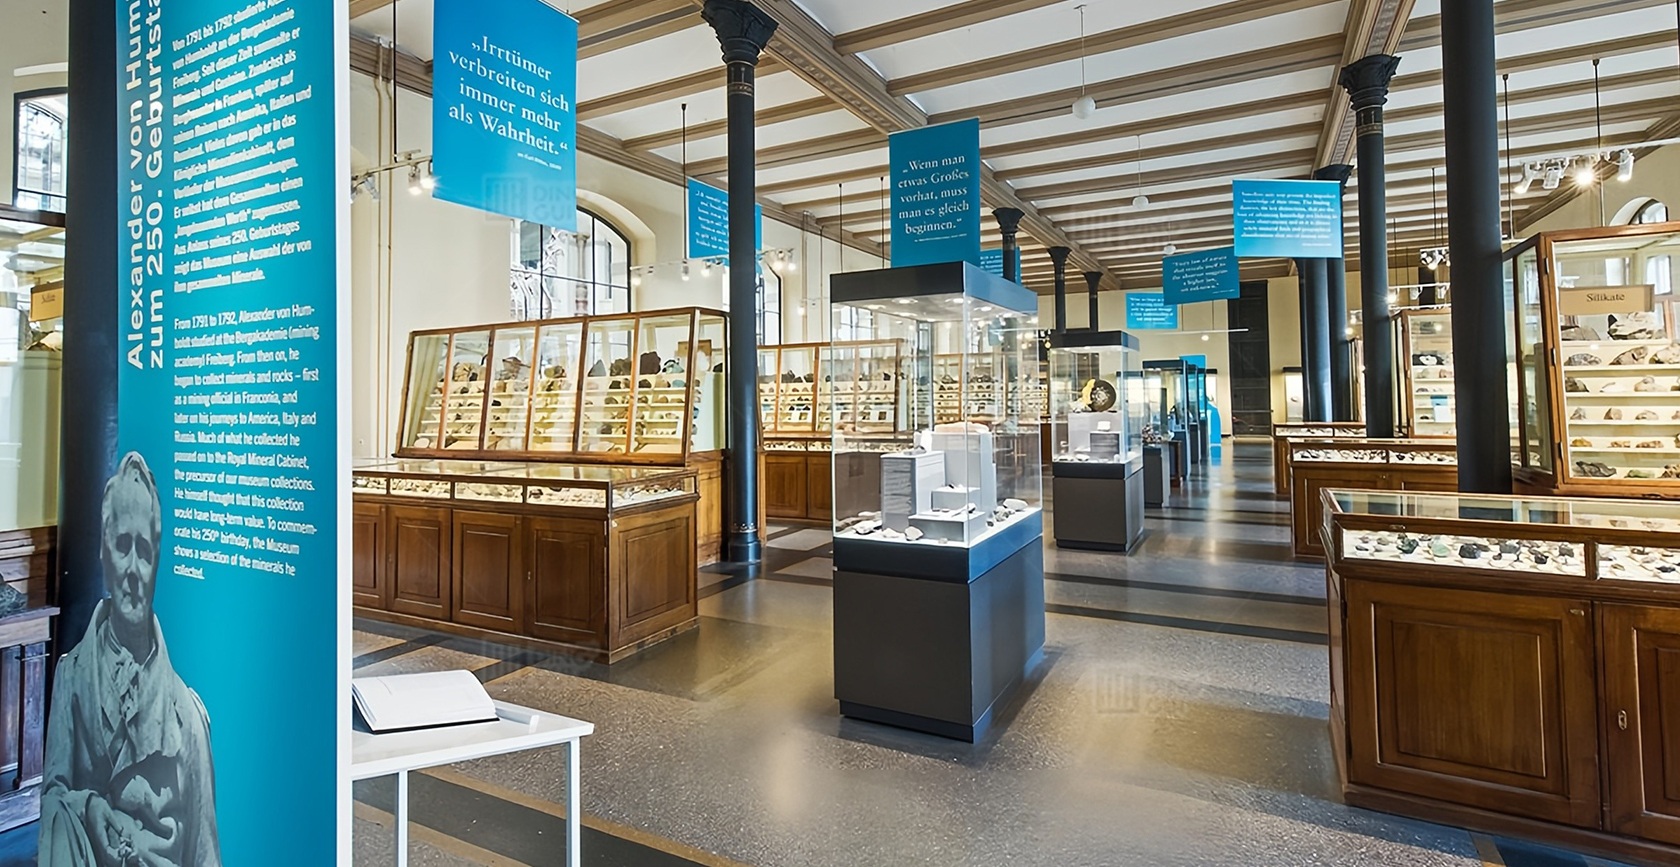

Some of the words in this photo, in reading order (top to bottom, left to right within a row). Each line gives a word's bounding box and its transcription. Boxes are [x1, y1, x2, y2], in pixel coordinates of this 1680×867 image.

[126, 0, 143, 90] Hum
[472, 35, 552, 81] „Irrtümer
[448, 51, 536, 98] verbreiten
[540, 90, 570, 113] sich
[459, 77, 516, 115] immer
[521, 106, 561, 132] mehr
[130, 100, 143, 169] von
[449, 103, 473, 125] als
[898, 177, 928, 188] etwas
[930, 169, 969, 184] Großes
[942, 155, 965, 166] man
[898, 209, 921, 219] man
[924, 206, 935, 216] es
[938, 200, 969, 217] gleich
[941, 186, 967, 198] muss
[147, 191, 163, 275] 250.
[127, 180, 143, 370] Alexander
[1586, 293, 1625, 302] Silikate
[150, 290, 163, 369] zum
